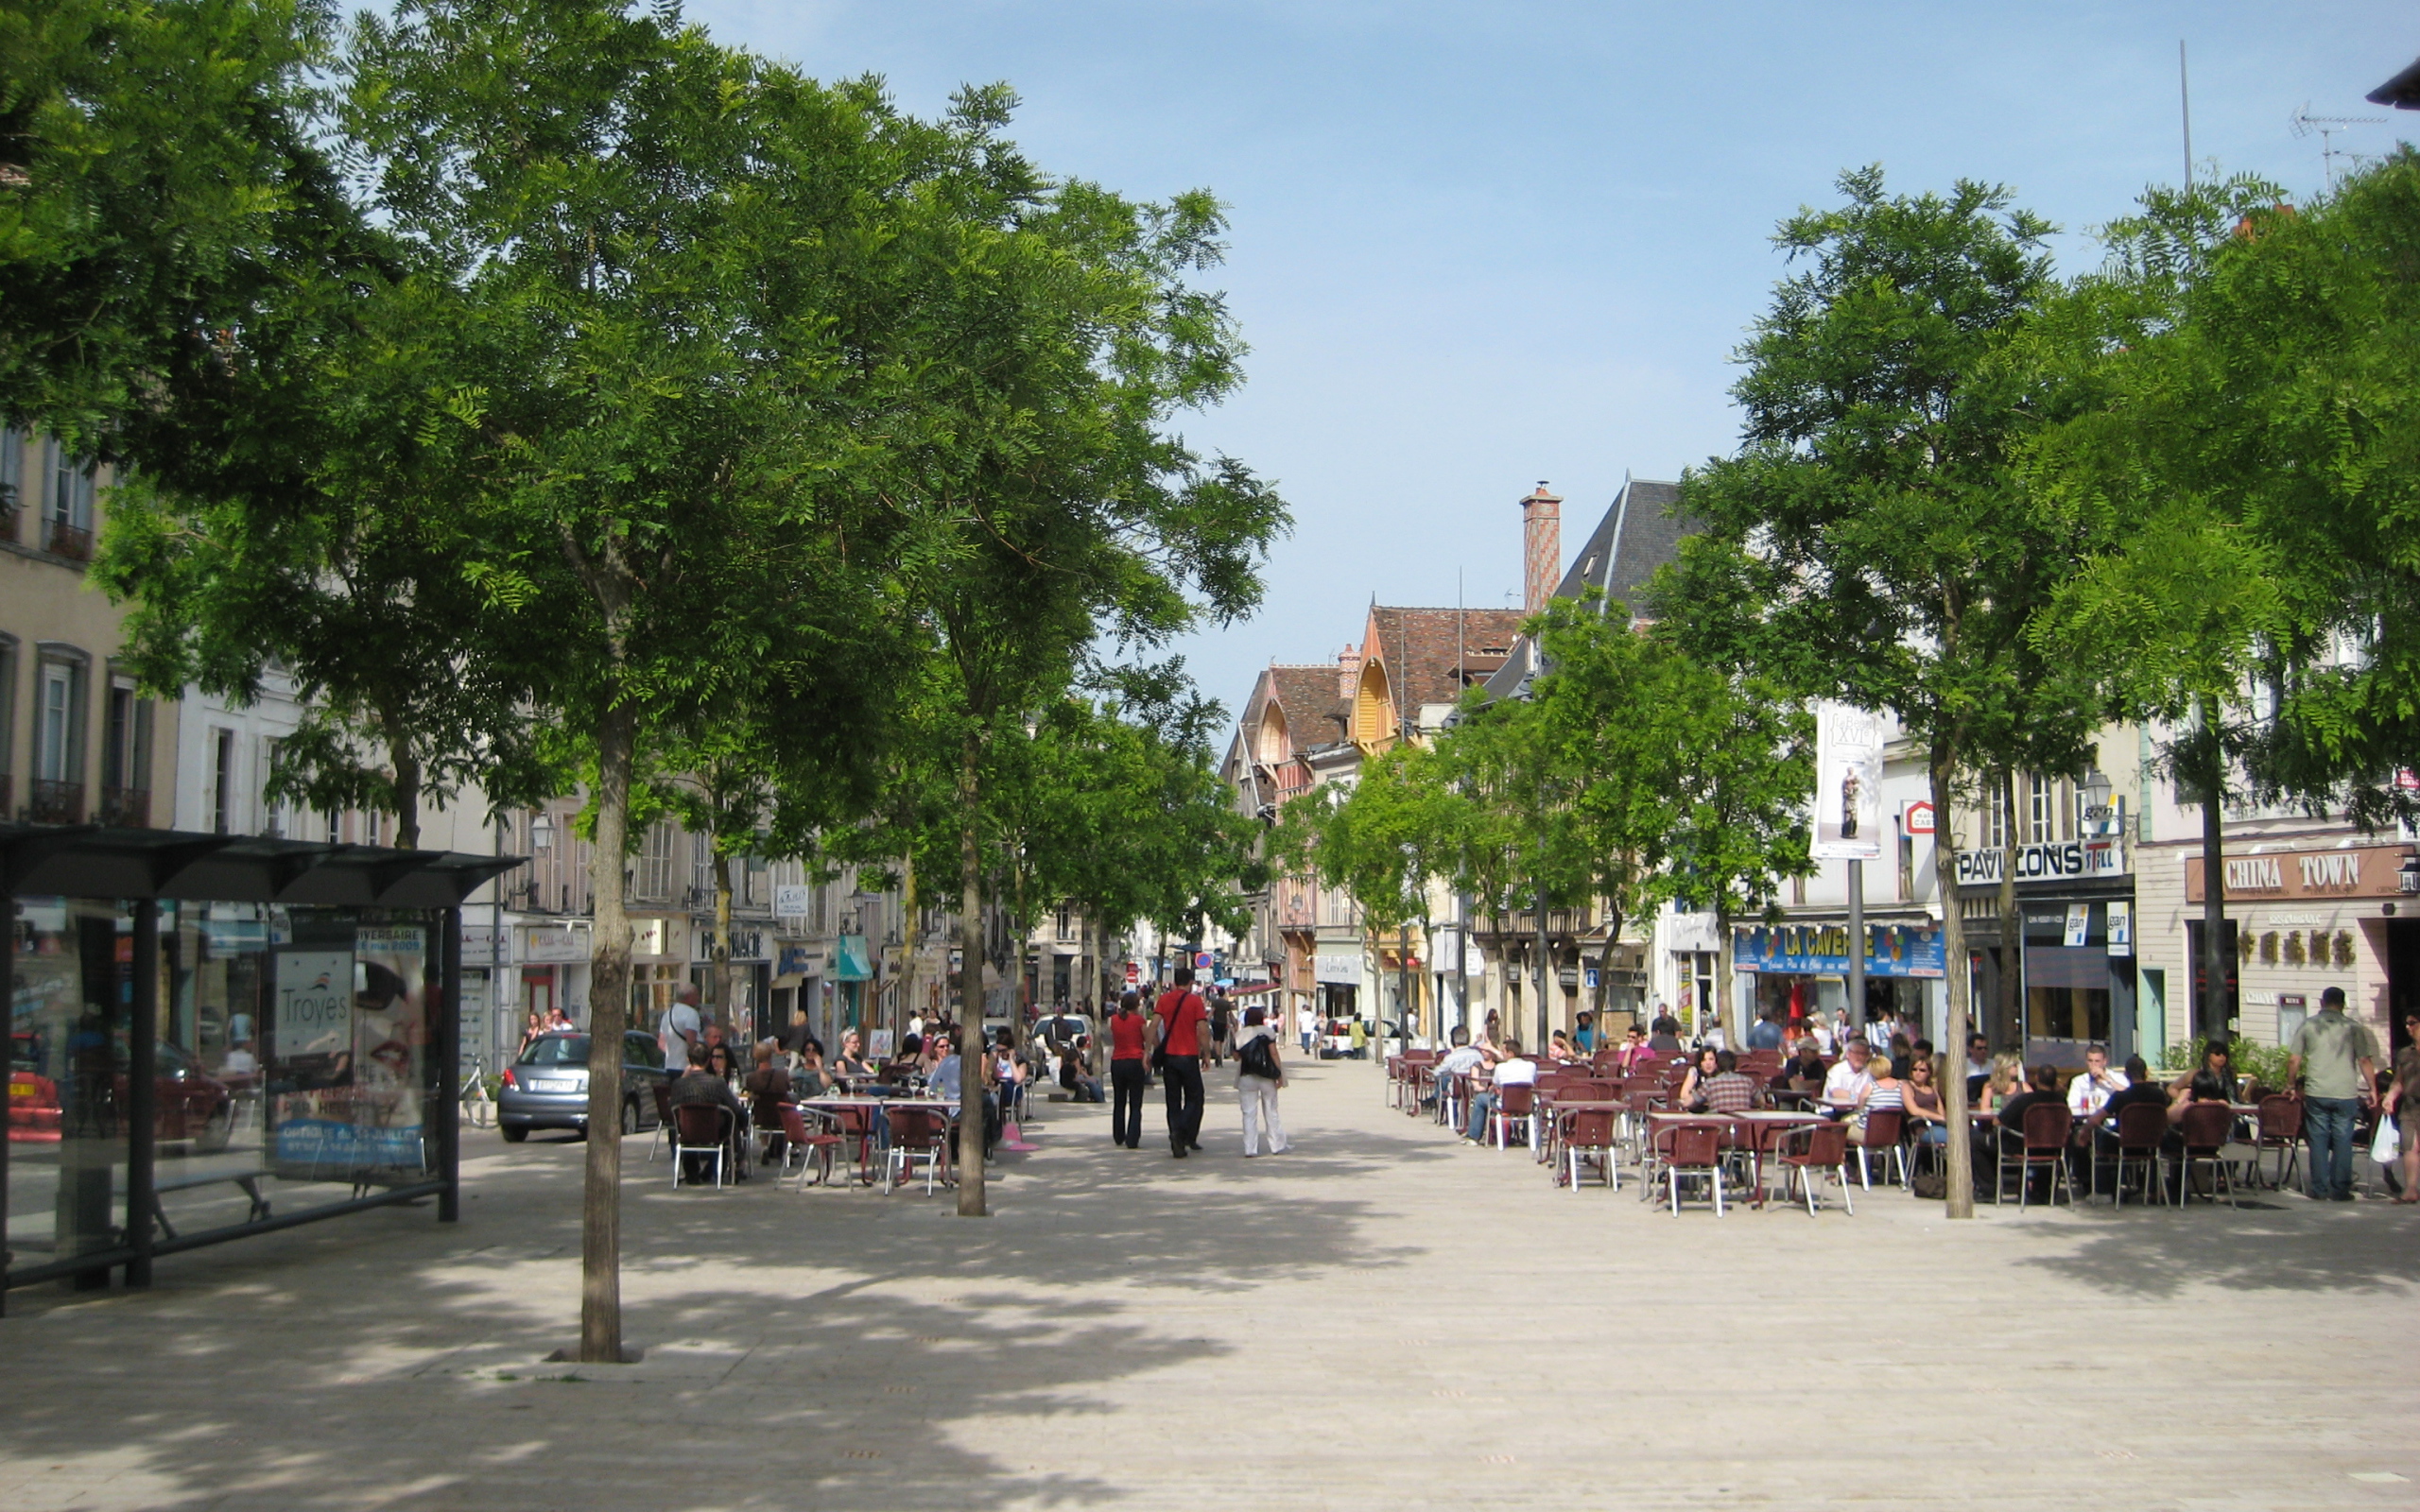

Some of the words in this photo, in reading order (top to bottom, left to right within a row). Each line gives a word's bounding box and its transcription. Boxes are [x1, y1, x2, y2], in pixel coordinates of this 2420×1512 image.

[1960, 845, 2083, 881] PAVILONS
[2224, 857, 2283, 889] CHINA
[2299, 853, 2360, 886] TOWN
[1785, 928, 1802, 955] LA
[281, 988, 347, 1032] Troyes
